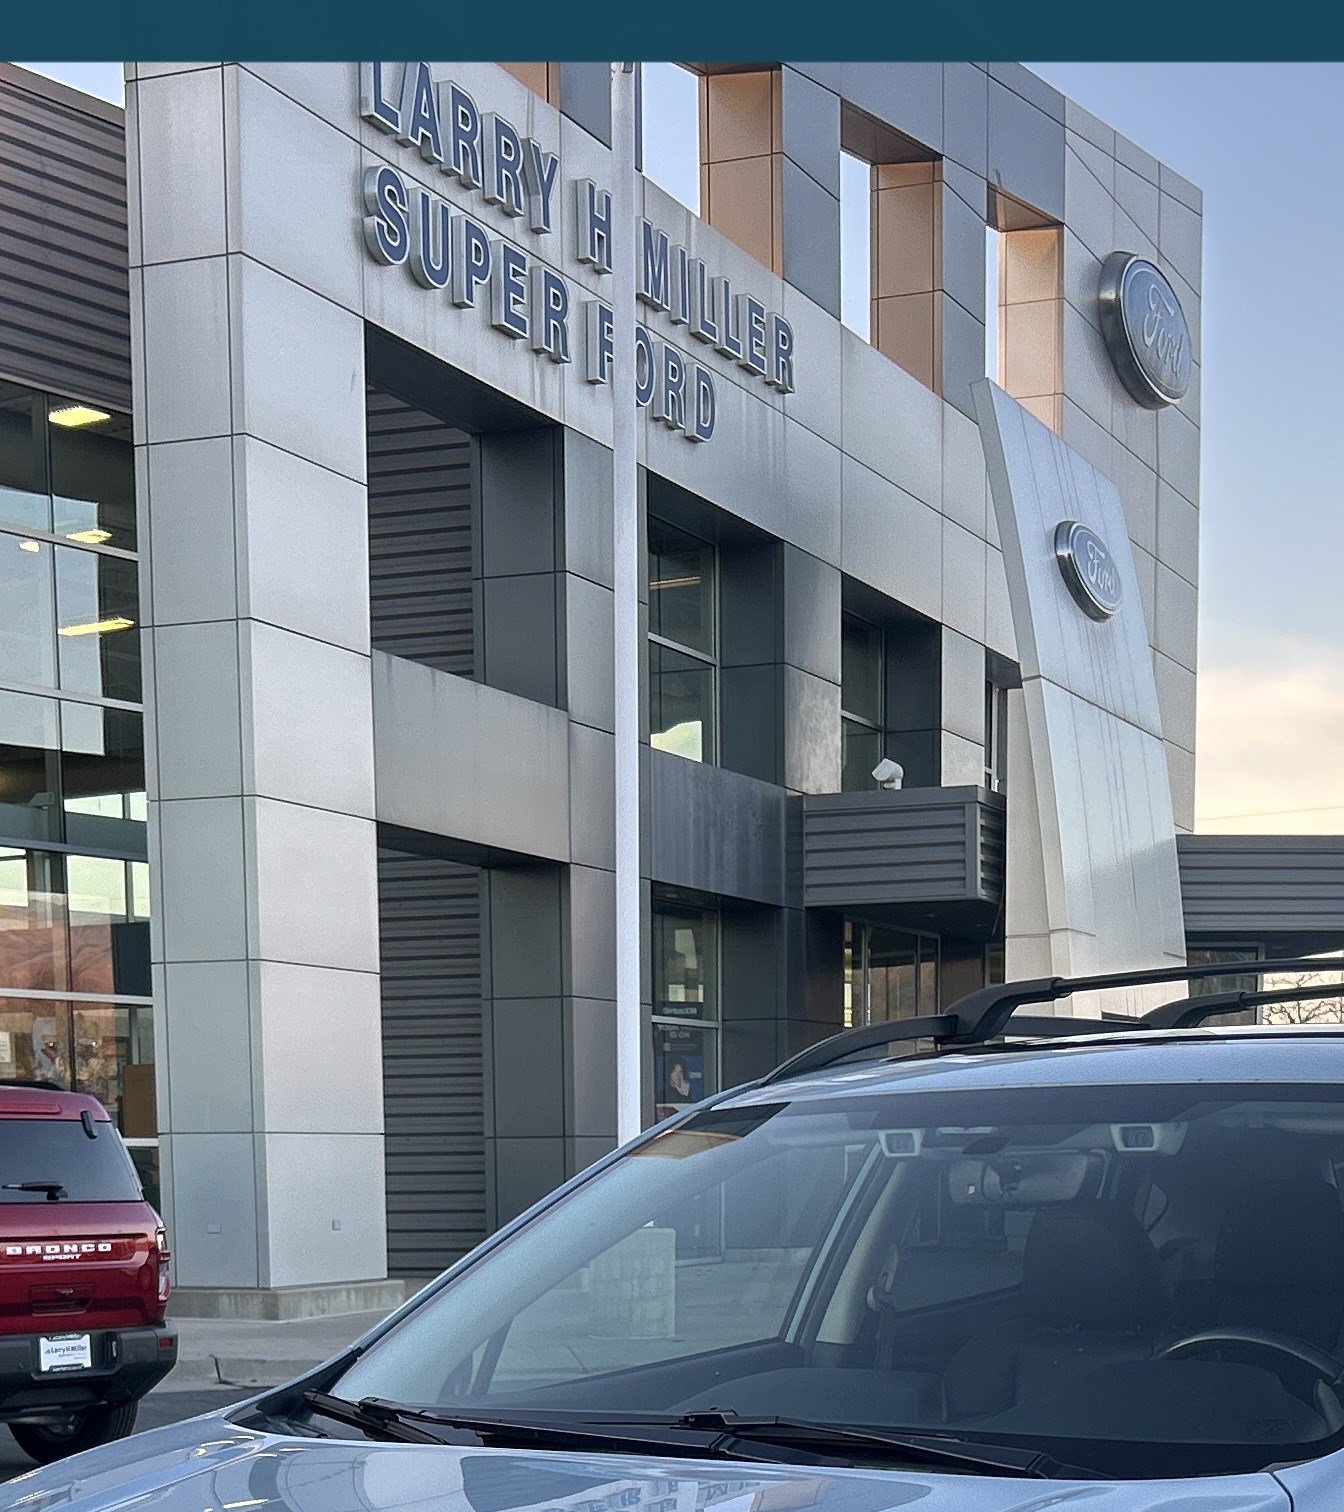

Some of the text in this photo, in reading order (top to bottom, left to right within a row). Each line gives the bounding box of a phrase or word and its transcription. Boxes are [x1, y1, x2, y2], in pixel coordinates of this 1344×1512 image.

[361, 62, 795, 394] LARRY H MILLER
[364, 165, 717, 443] SUPER FORD
[1142, 284, 1185, 379] Ford
[1087, 540, 1117, 597] Ford
[6, 1243, 112, 1256] BRONCO
